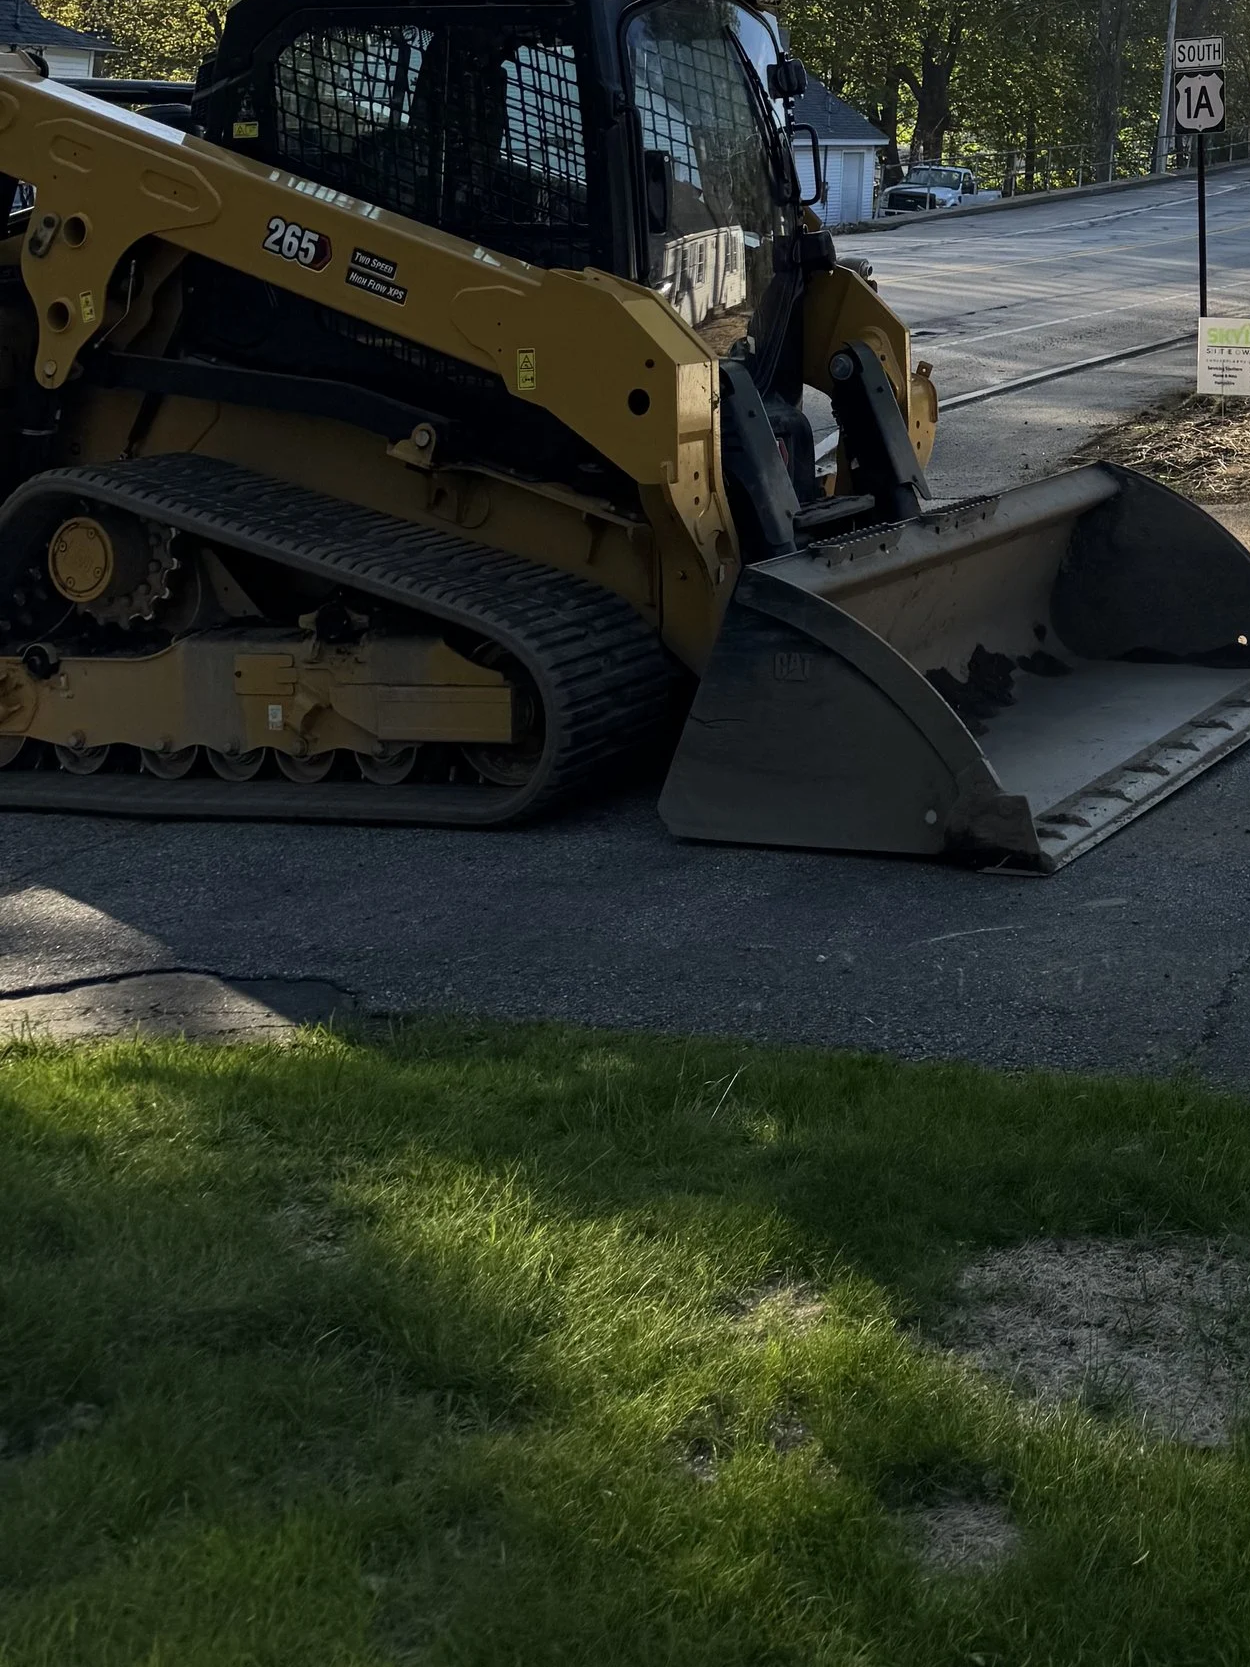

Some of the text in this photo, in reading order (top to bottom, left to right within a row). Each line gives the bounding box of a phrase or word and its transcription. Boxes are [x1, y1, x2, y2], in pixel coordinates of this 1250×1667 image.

[1178, 44, 1221, 63] SOUTH
[1185, 86, 1214, 118] 1A
[264, 218, 321, 265] 265
[354, 251, 394, 274] TWO SPEED
[349, 271, 405, 300] HIGH FLOW XPS
[773, 652, 811, 683] CAT
